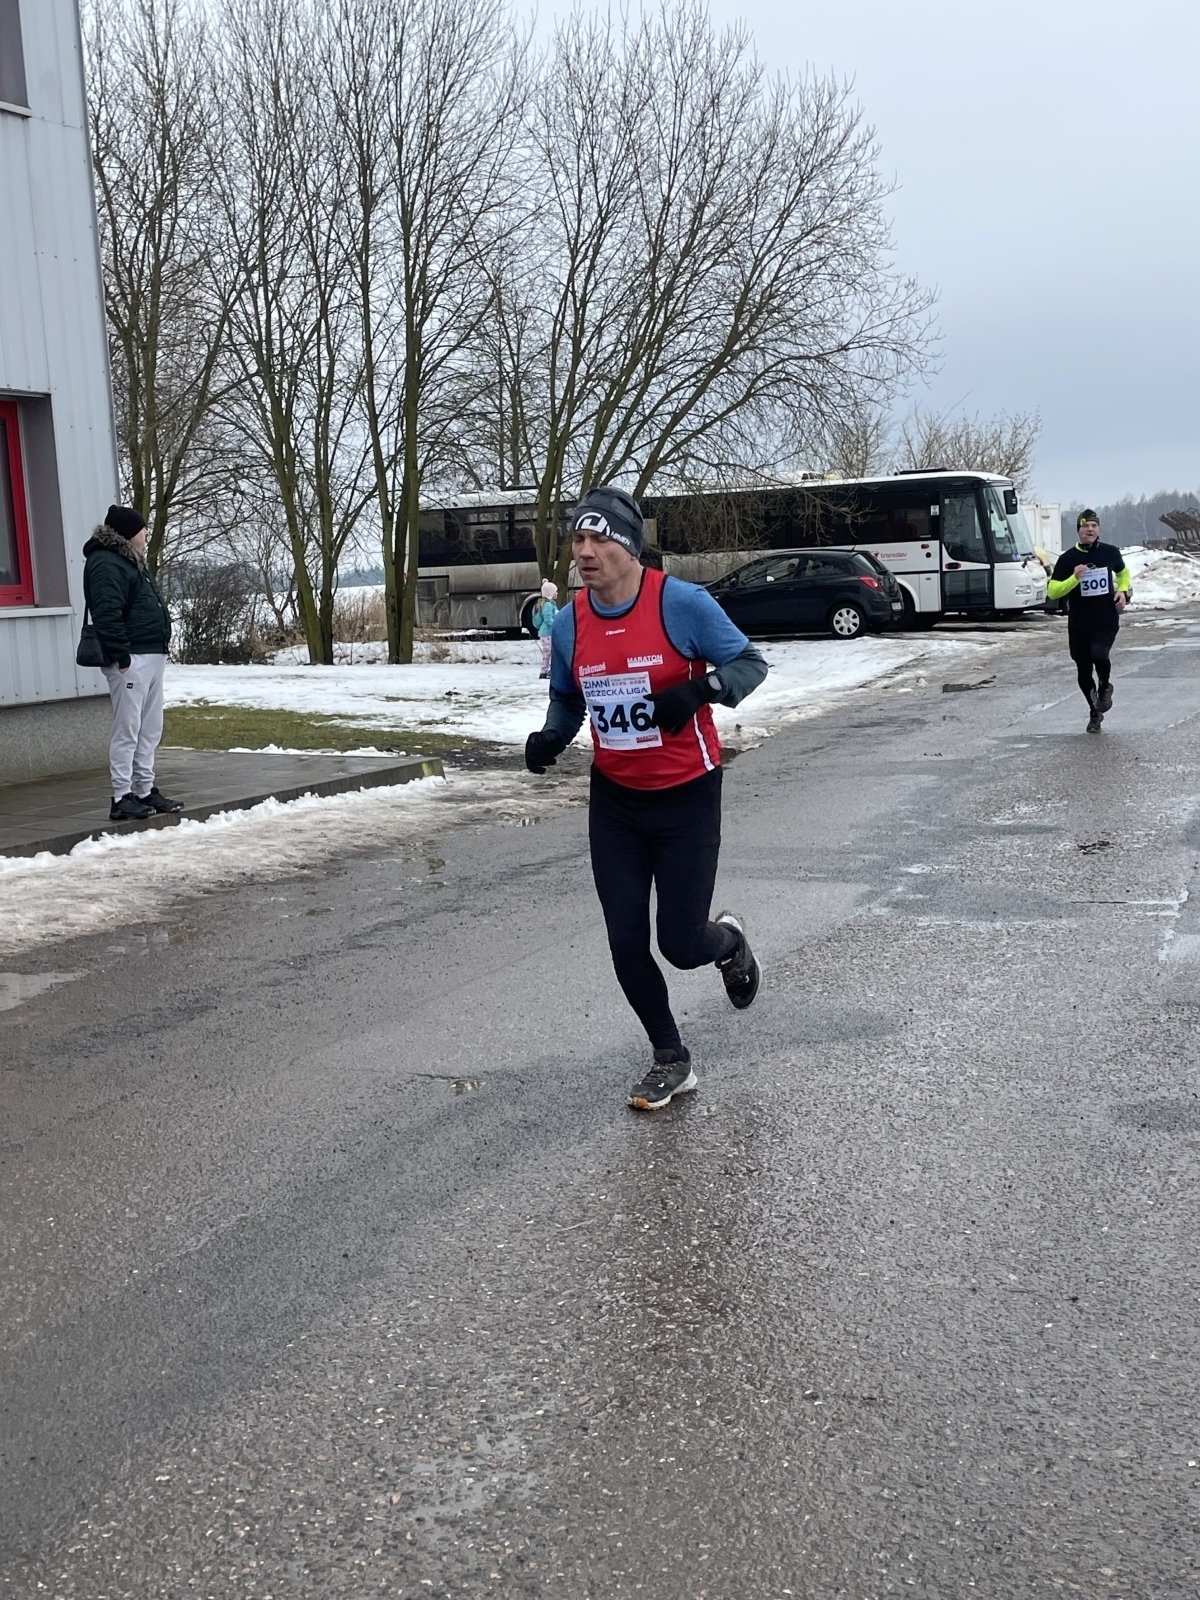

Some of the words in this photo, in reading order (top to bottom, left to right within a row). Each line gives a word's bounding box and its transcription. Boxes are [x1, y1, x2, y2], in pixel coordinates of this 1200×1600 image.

[610, 531, 630, 545] HAVEN
[1082, 578, 1107, 591] 300
[627, 654, 663, 663] MARATON
[583, 678, 610, 689] ZIMNÍ
[626, 687, 649, 695] LIGA
[592, 702, 652, 733] 346
